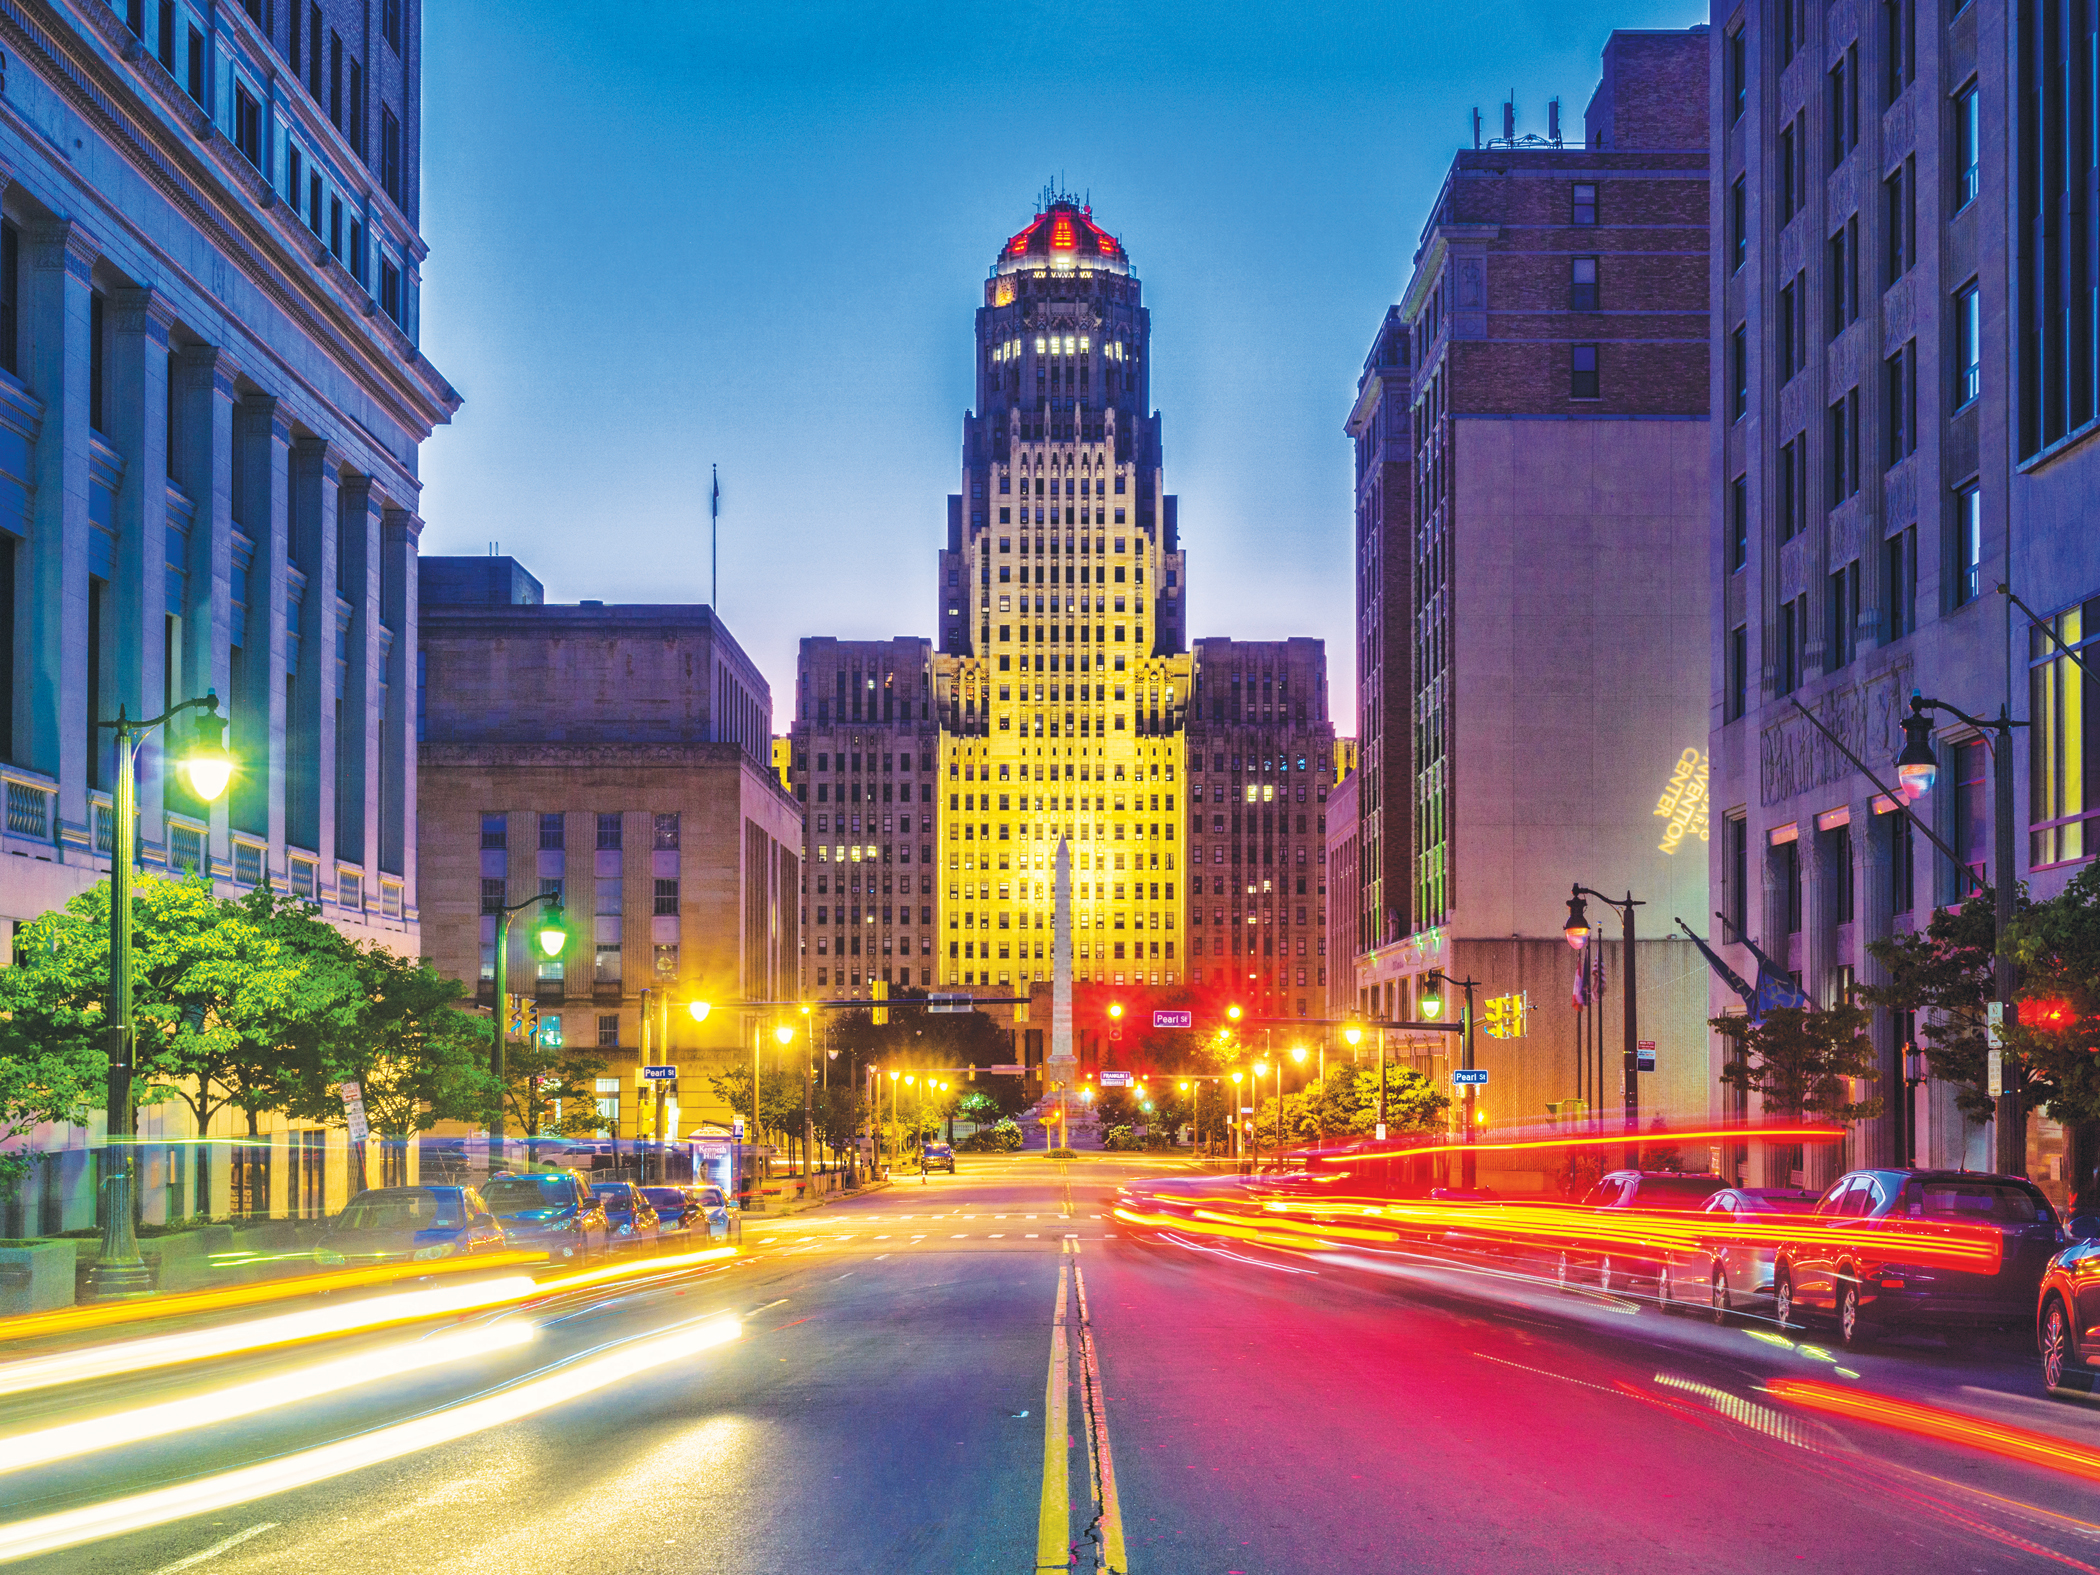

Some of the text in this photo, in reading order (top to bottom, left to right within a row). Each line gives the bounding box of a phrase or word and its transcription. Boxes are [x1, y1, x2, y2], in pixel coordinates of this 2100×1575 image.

[1653, 747, 1699, 818] CENTER
[1157, 1015, 1178, 1023] Pearl
[645, 1069, 665, 1077] Pearl
[1456, 1073, 1476, 1081] Pearl
